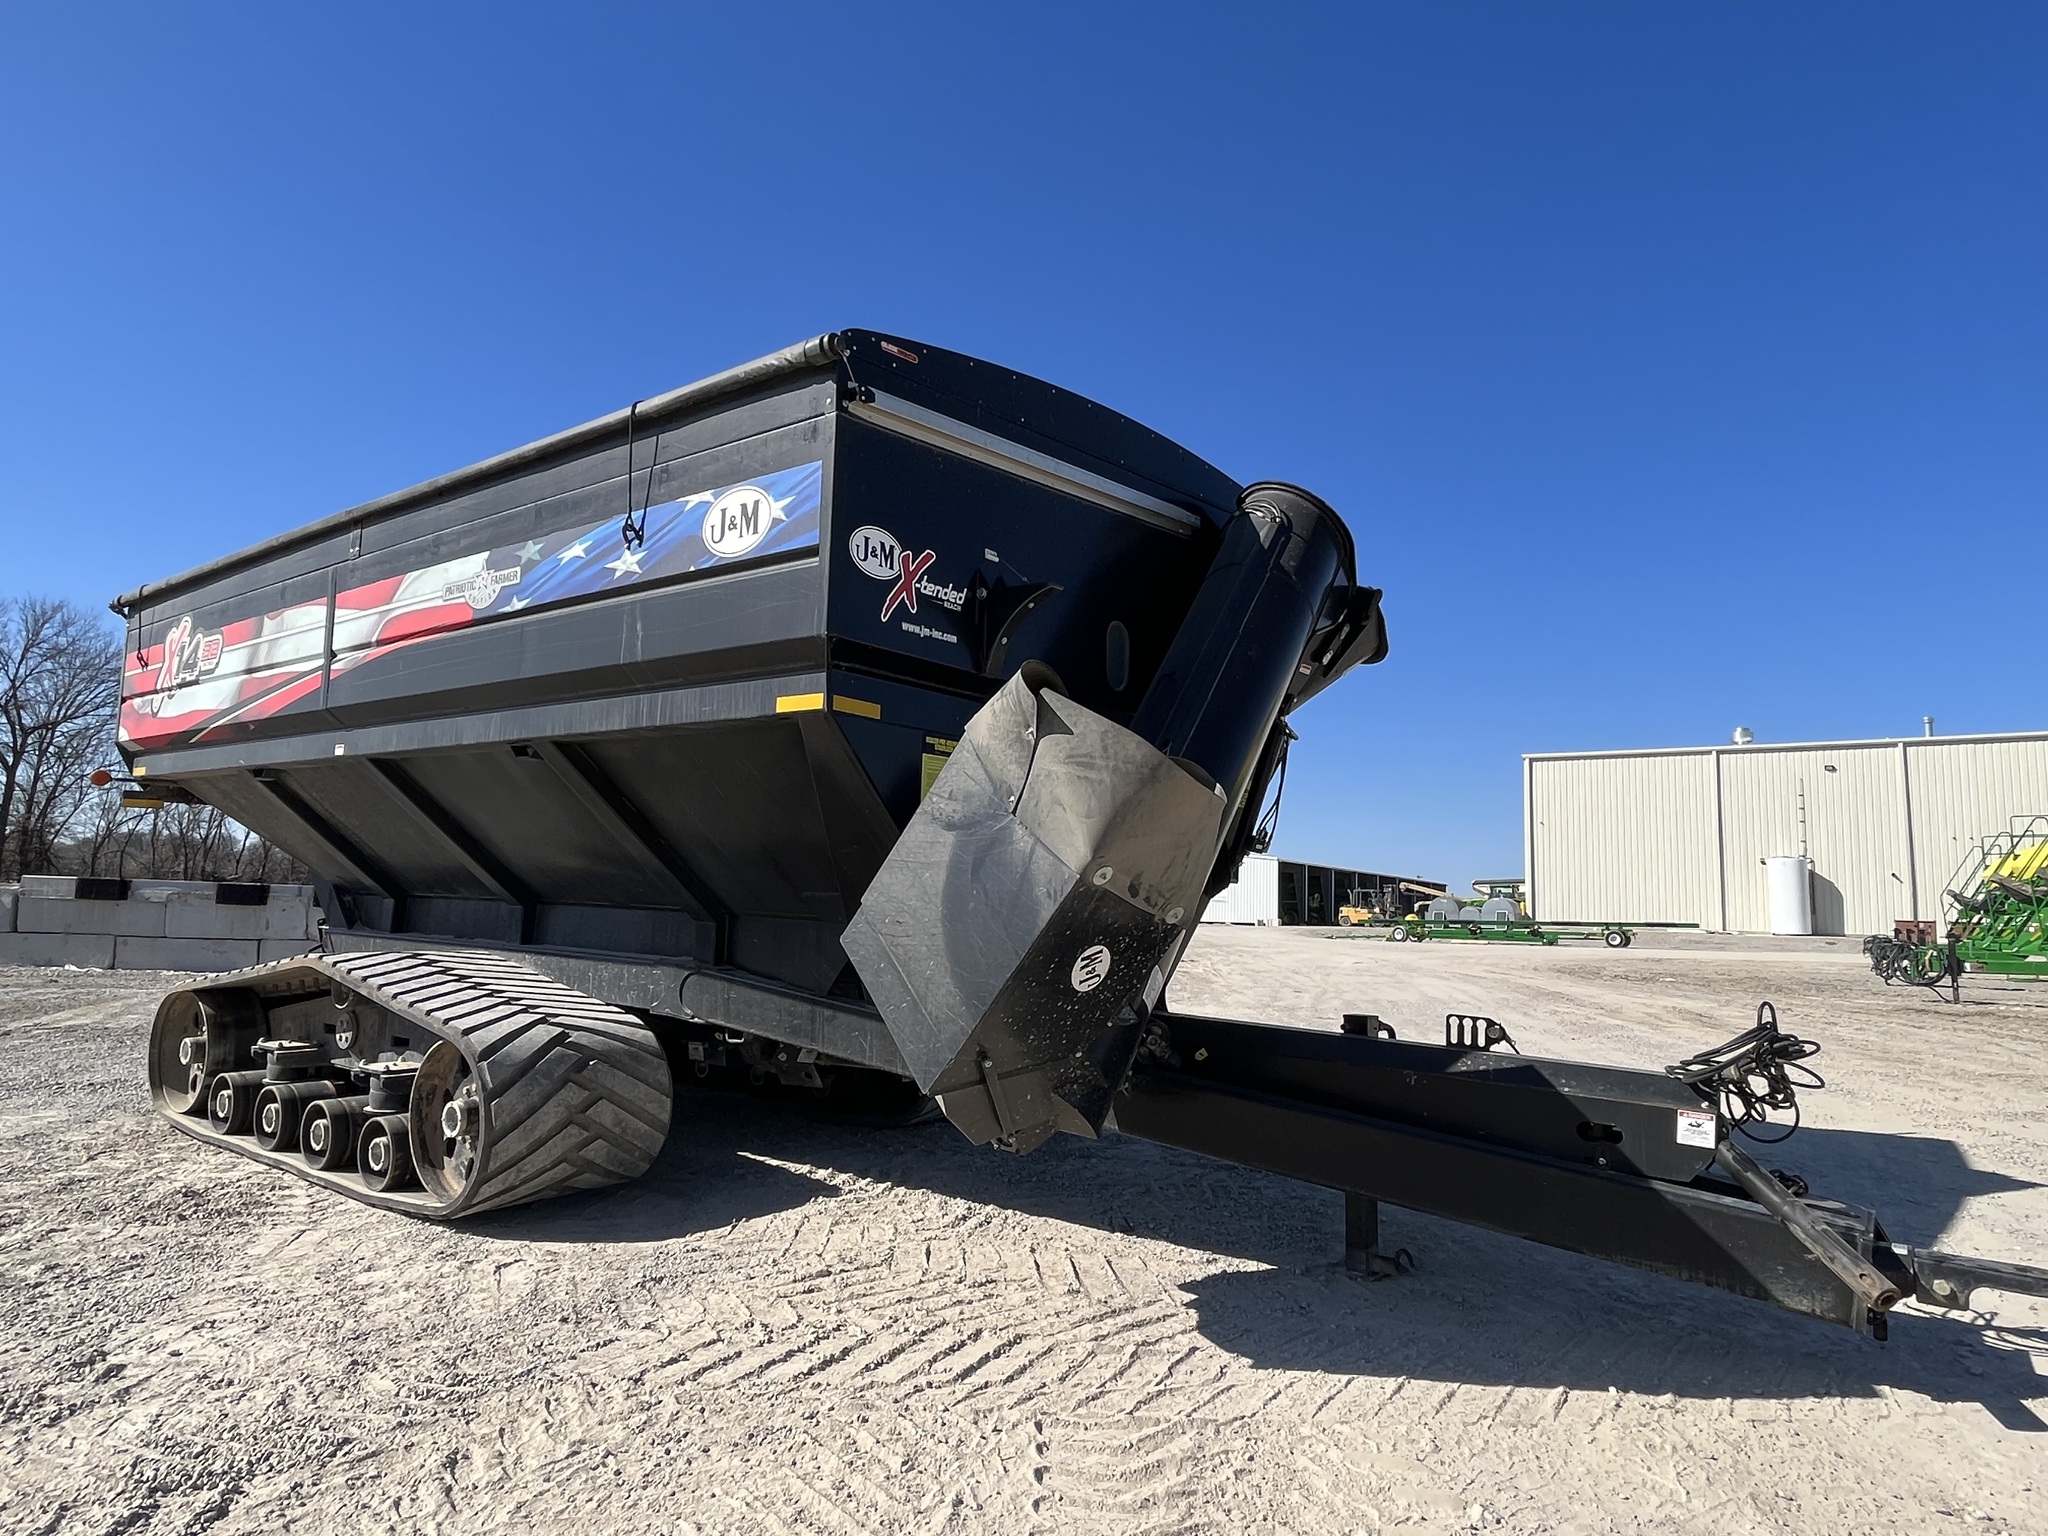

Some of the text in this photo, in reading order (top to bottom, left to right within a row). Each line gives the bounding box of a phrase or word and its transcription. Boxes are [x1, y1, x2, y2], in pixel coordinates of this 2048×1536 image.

[710, 499, 761, 544] J&M
[855, 535, 896, 572] J&M
[444, 570, 518, 598] PATRIOTIC FARMER
[881, 549, 968, 623] X-tended
[901, 621, 958, 644] www.jm-inc.com
[1079, 948, 1104, 988] J&M
